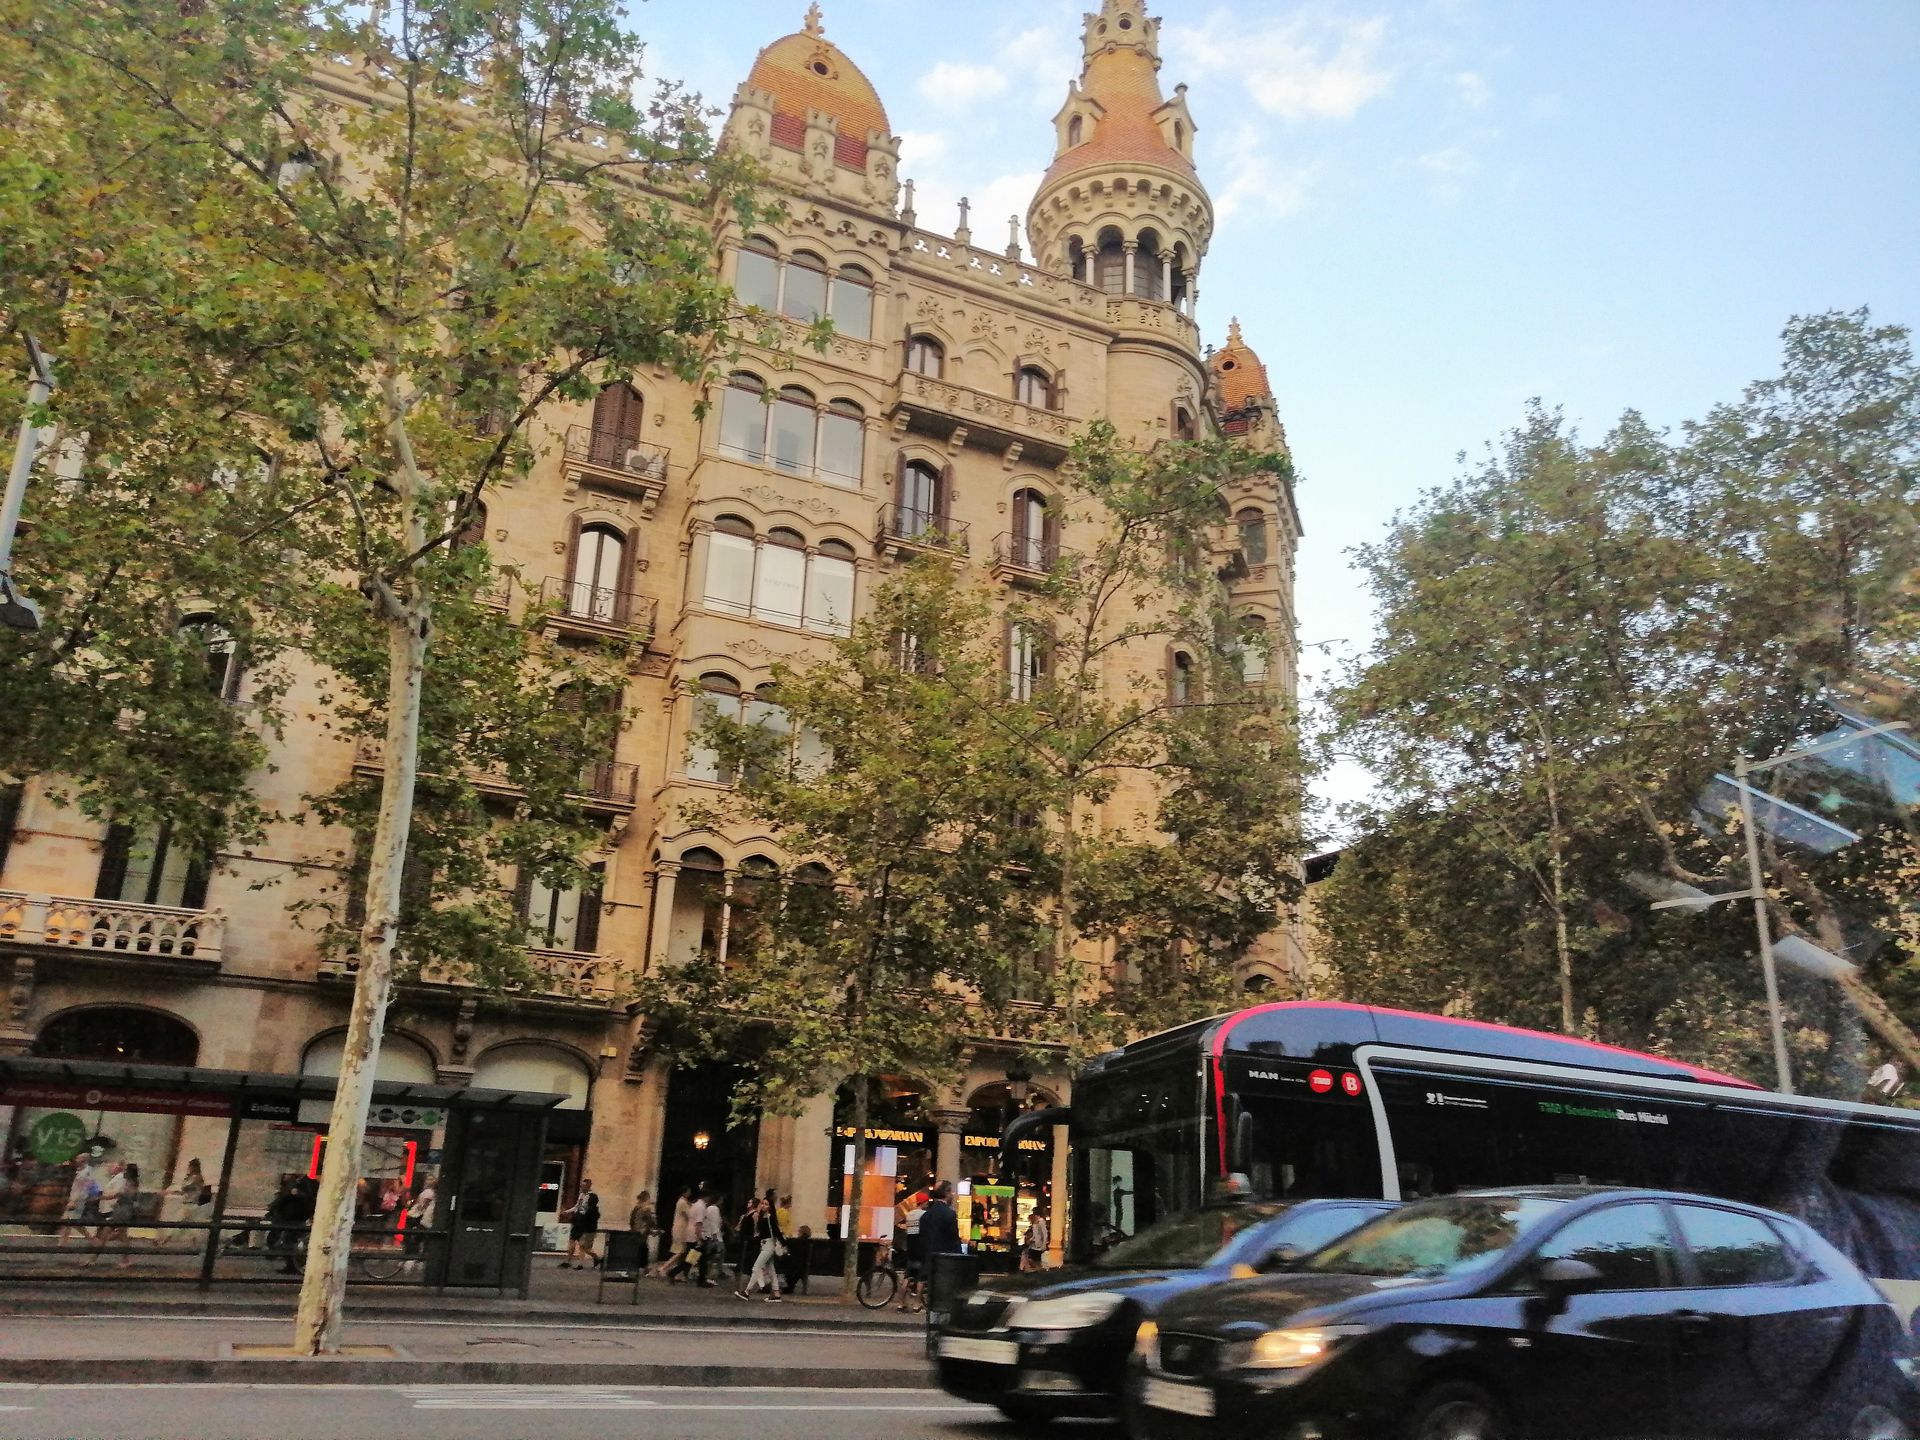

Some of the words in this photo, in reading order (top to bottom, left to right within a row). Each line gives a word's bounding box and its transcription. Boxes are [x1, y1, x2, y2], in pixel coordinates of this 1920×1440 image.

[1248, 1070, 1279, 1080] MAN
[1346, 1076, 1358, 1091] B
[38, 1128, 81, 1148] V15
[964, 1135, 1002, 1147] EMPORI
